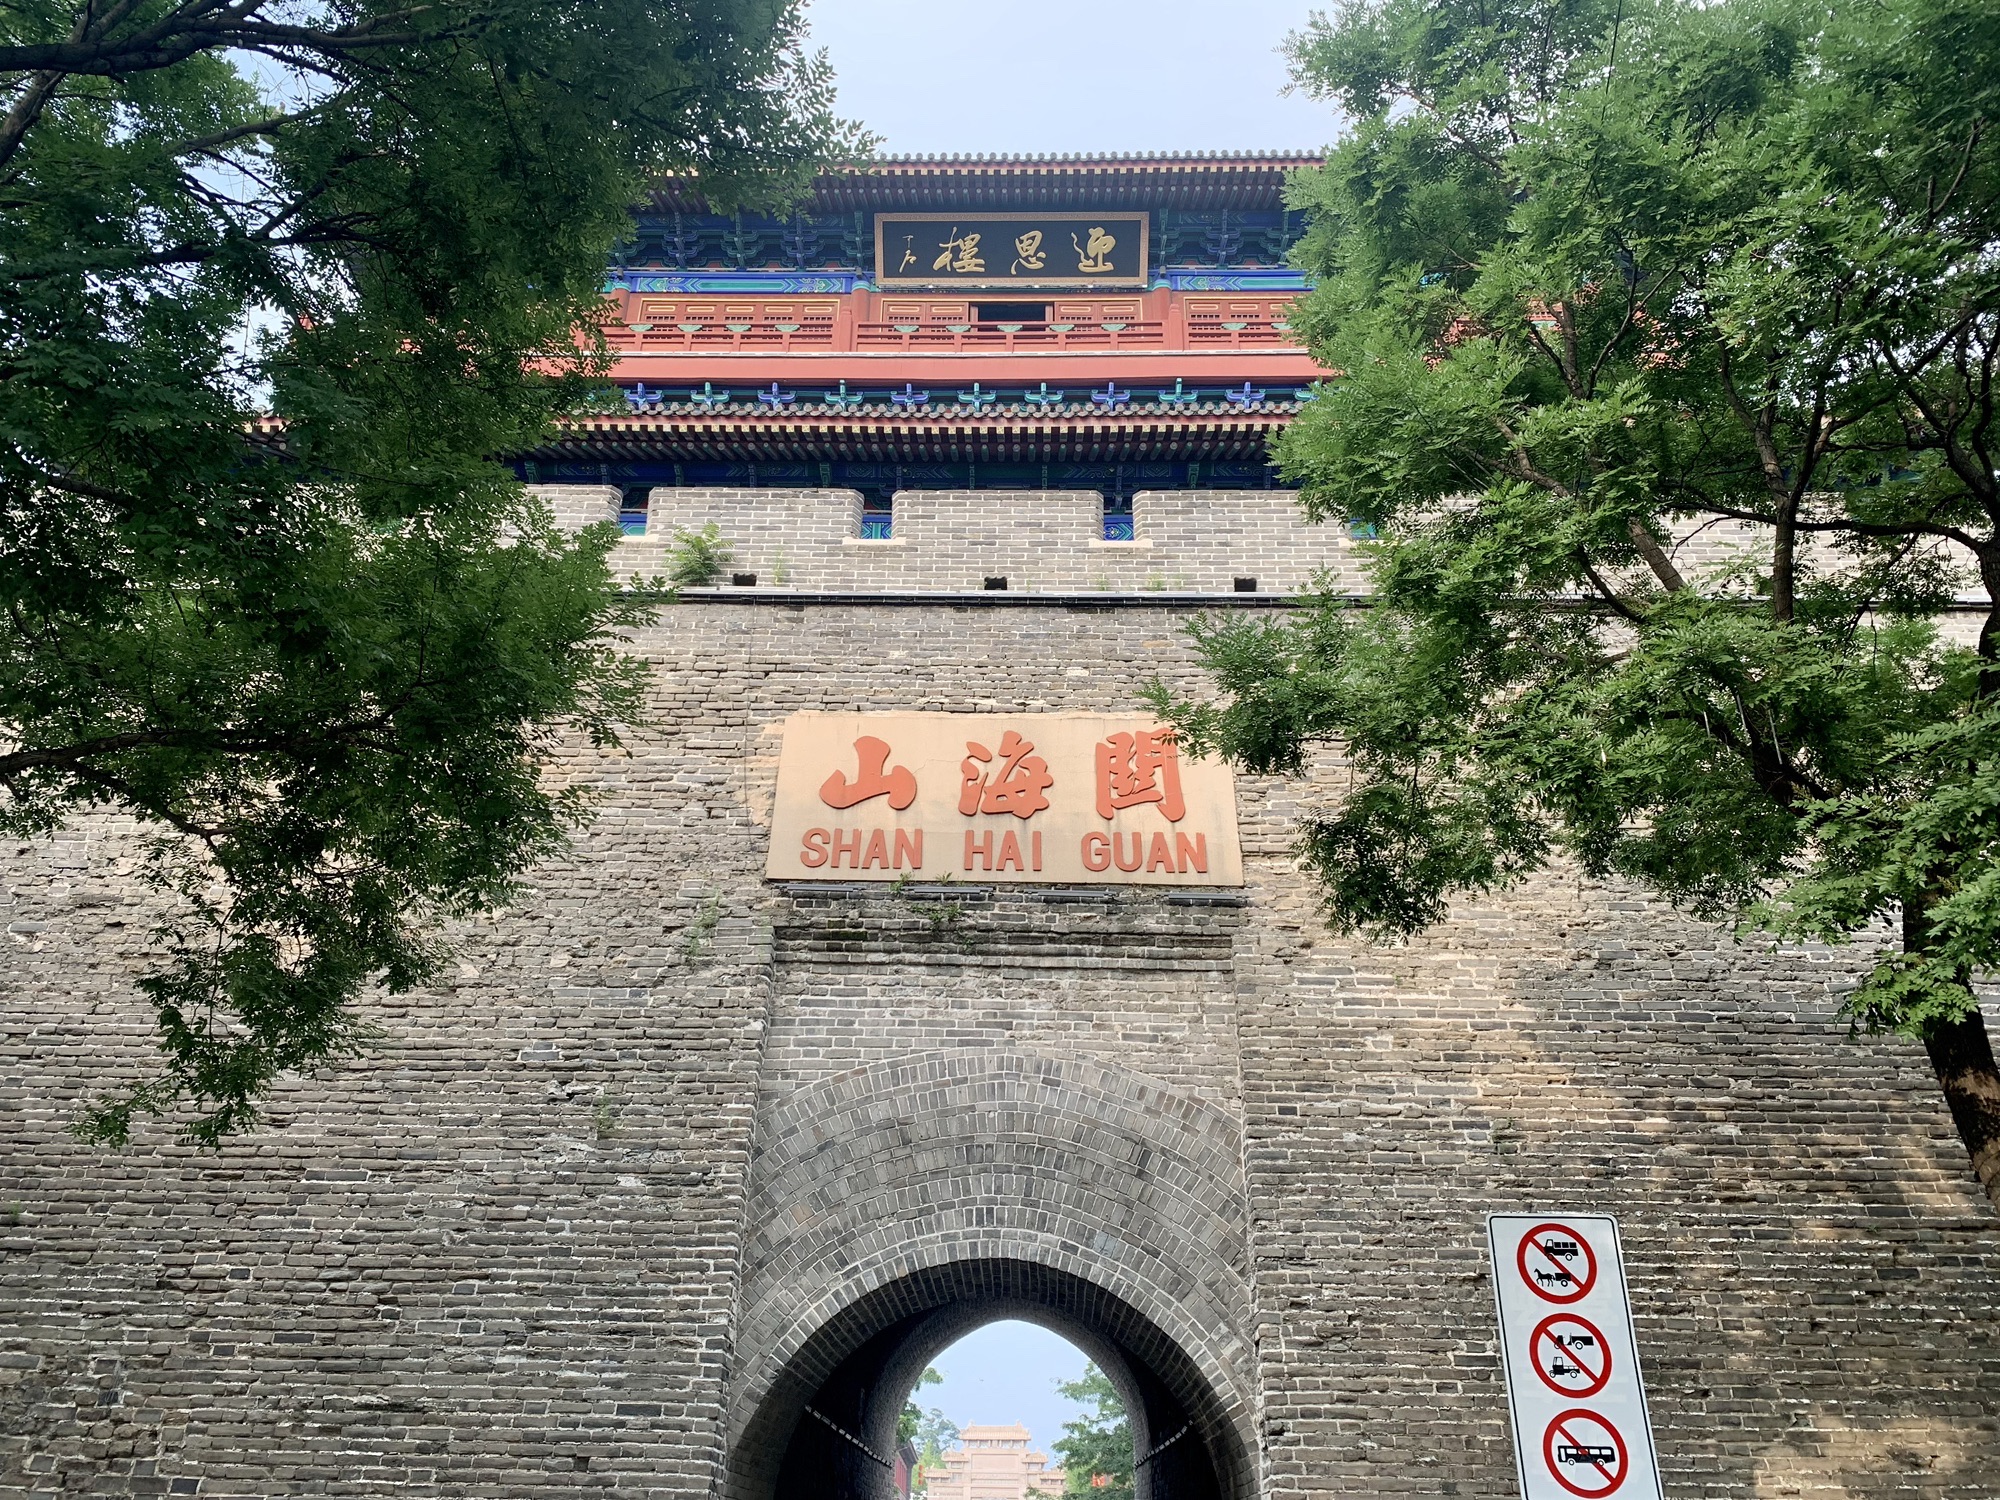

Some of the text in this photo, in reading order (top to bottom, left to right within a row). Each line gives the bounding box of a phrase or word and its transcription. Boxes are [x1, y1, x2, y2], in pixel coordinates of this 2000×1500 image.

[801, 828, 1208, 873] SHAN HAI GUAN
